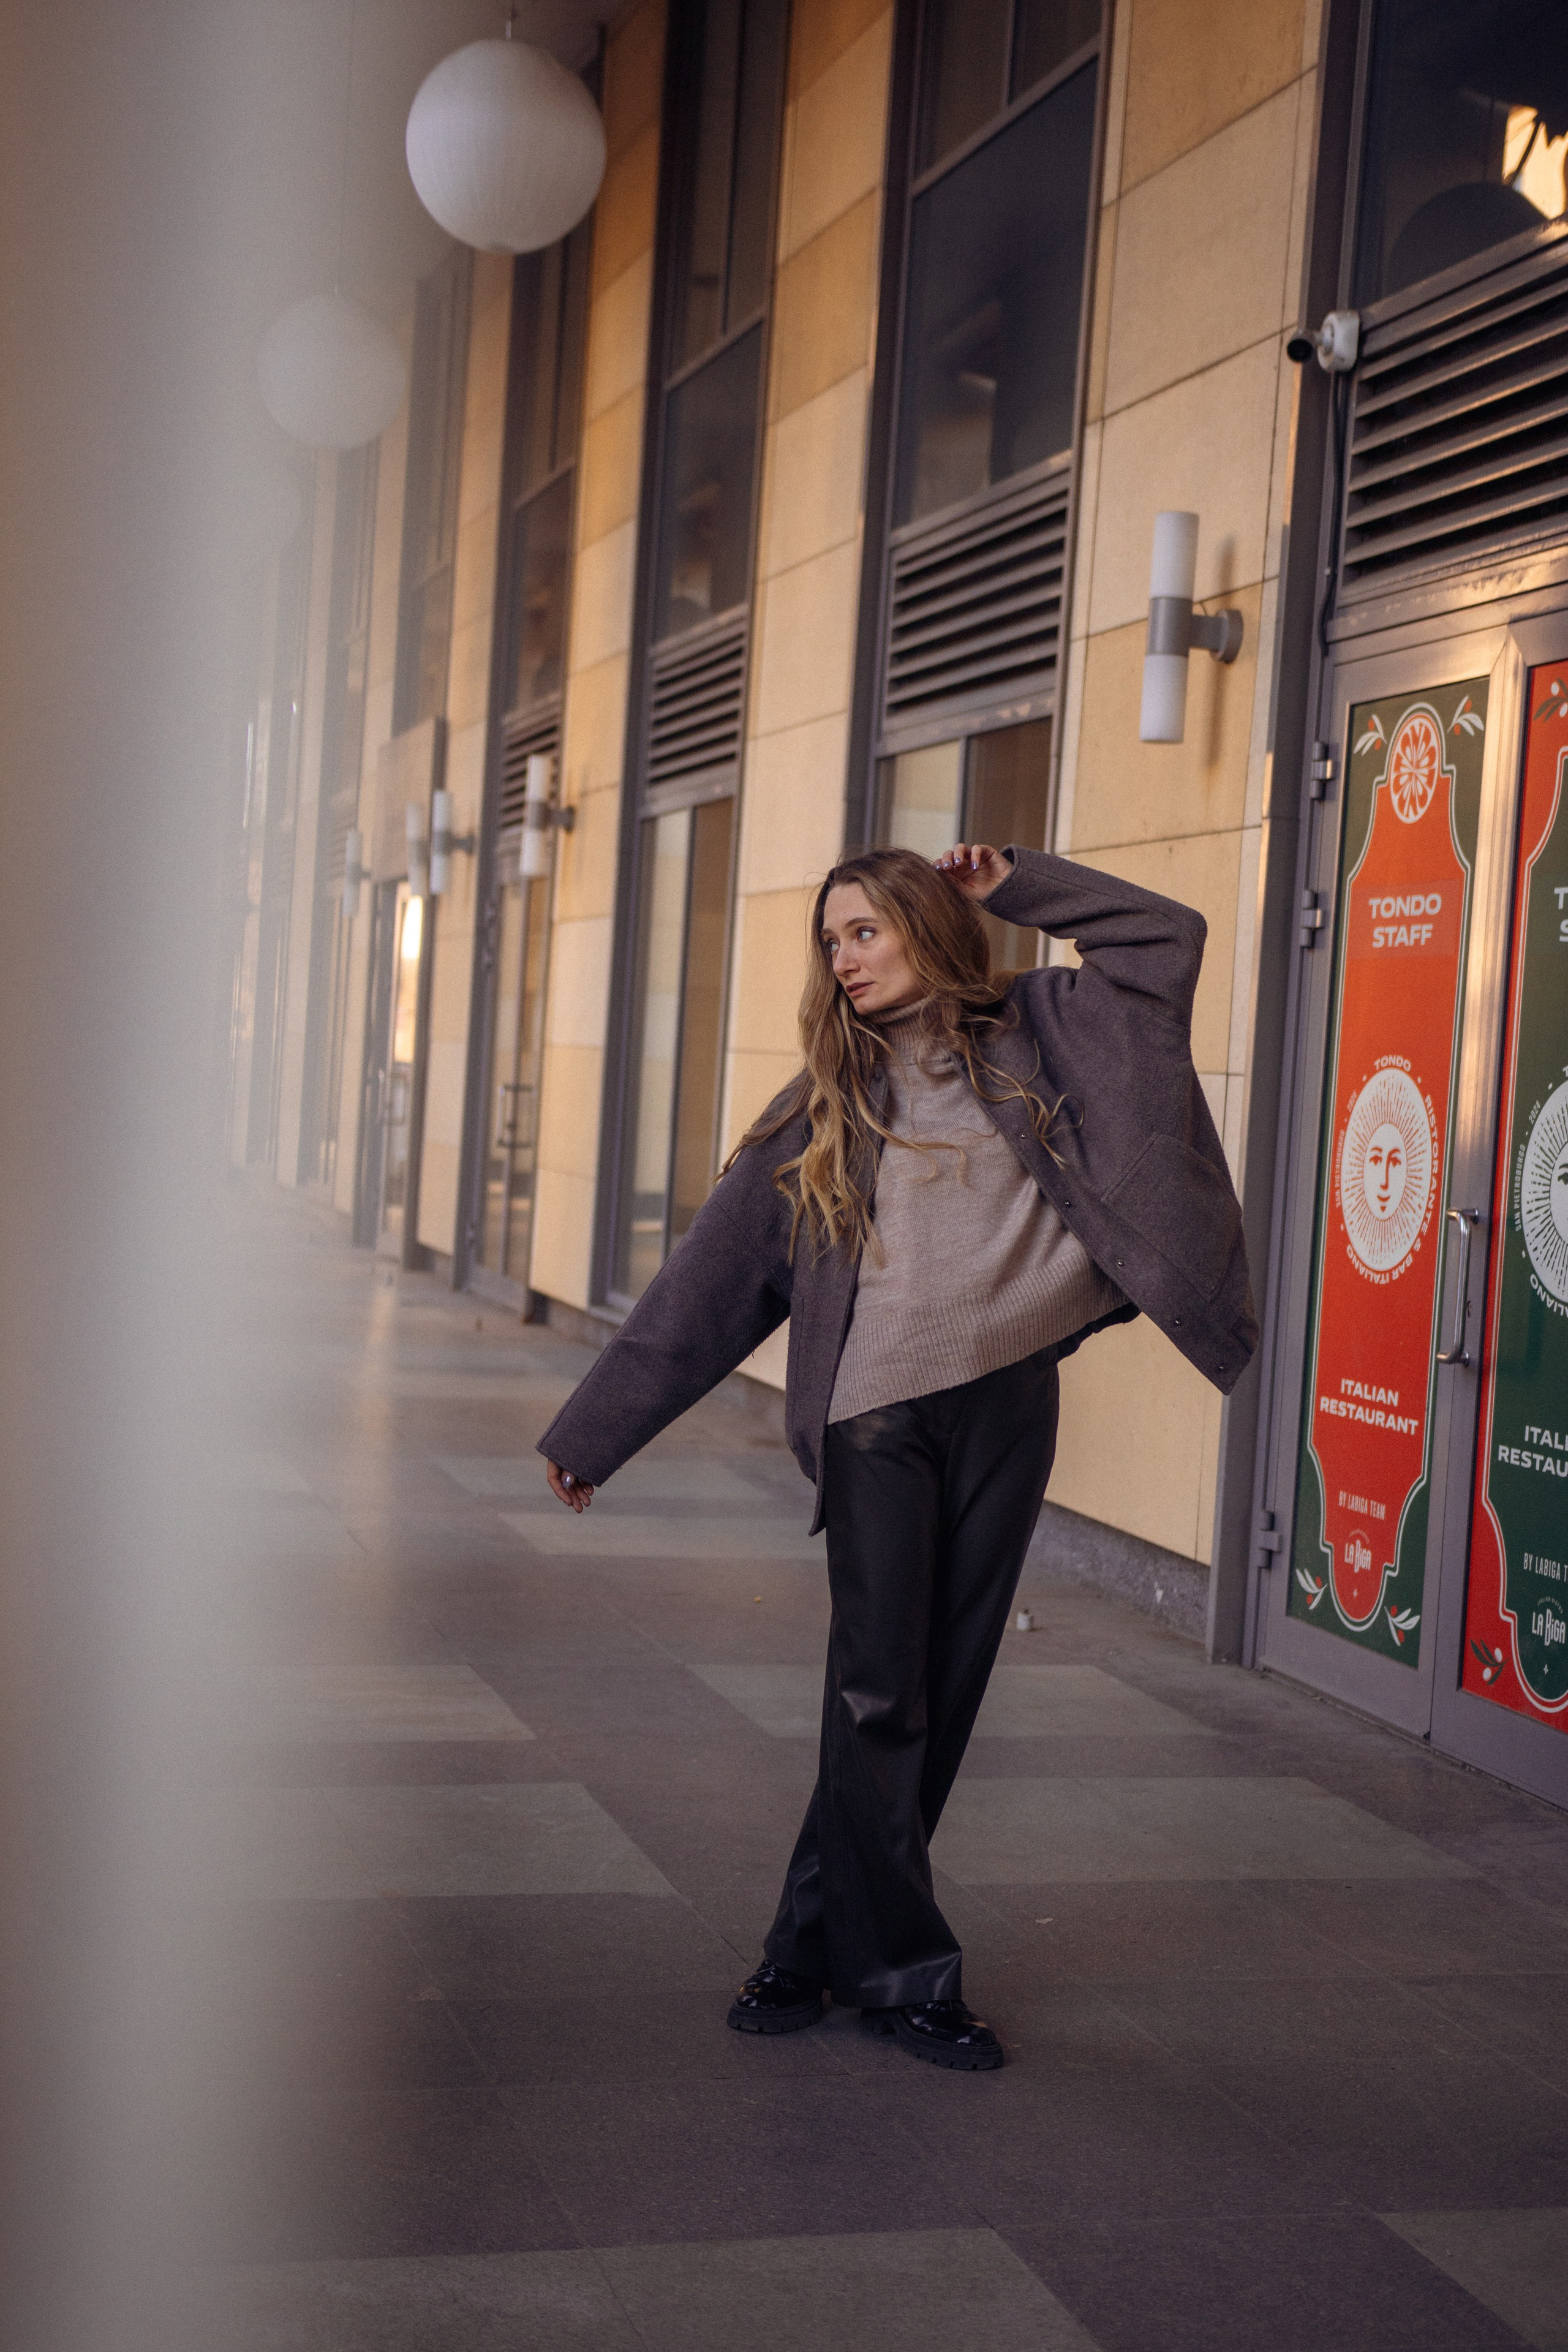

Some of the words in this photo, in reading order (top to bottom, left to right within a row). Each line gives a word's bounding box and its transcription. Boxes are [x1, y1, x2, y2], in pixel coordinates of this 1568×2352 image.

[1368, 893, 1441, 919] TONDO
[1373, 923, 1433, 948] STAFF
[1374, 1055, 1411, 1071] TONDO
[1421, 1094, 1438, 1236] RISTORANTE
[1514, 1144, 1526, 1210] PIETROBURGO
[1529, 1101, 1540, 1125] 2024
[1347, 1244, 1389, 1284] ITALIANO
[1392, 1253, 1412, 1280] BAR
[1341, 1378, 1398, 1407] ITALIAN
[1320, 1396, 1419, 1436] RESTAURANT
[1339, 1490, 1346, 1507] BY
[1348, 1493, 1368, 1515] LABIGA
[1370, 1499, 1385, 1520] TEAM
[1344, 1542, 1354, 1564] LA
[1523, 1552, 1532, 1571] BY
[1535, 1556, 1560, 1580] LABIGA
[1532, 1611, 1544, 1637] LA
